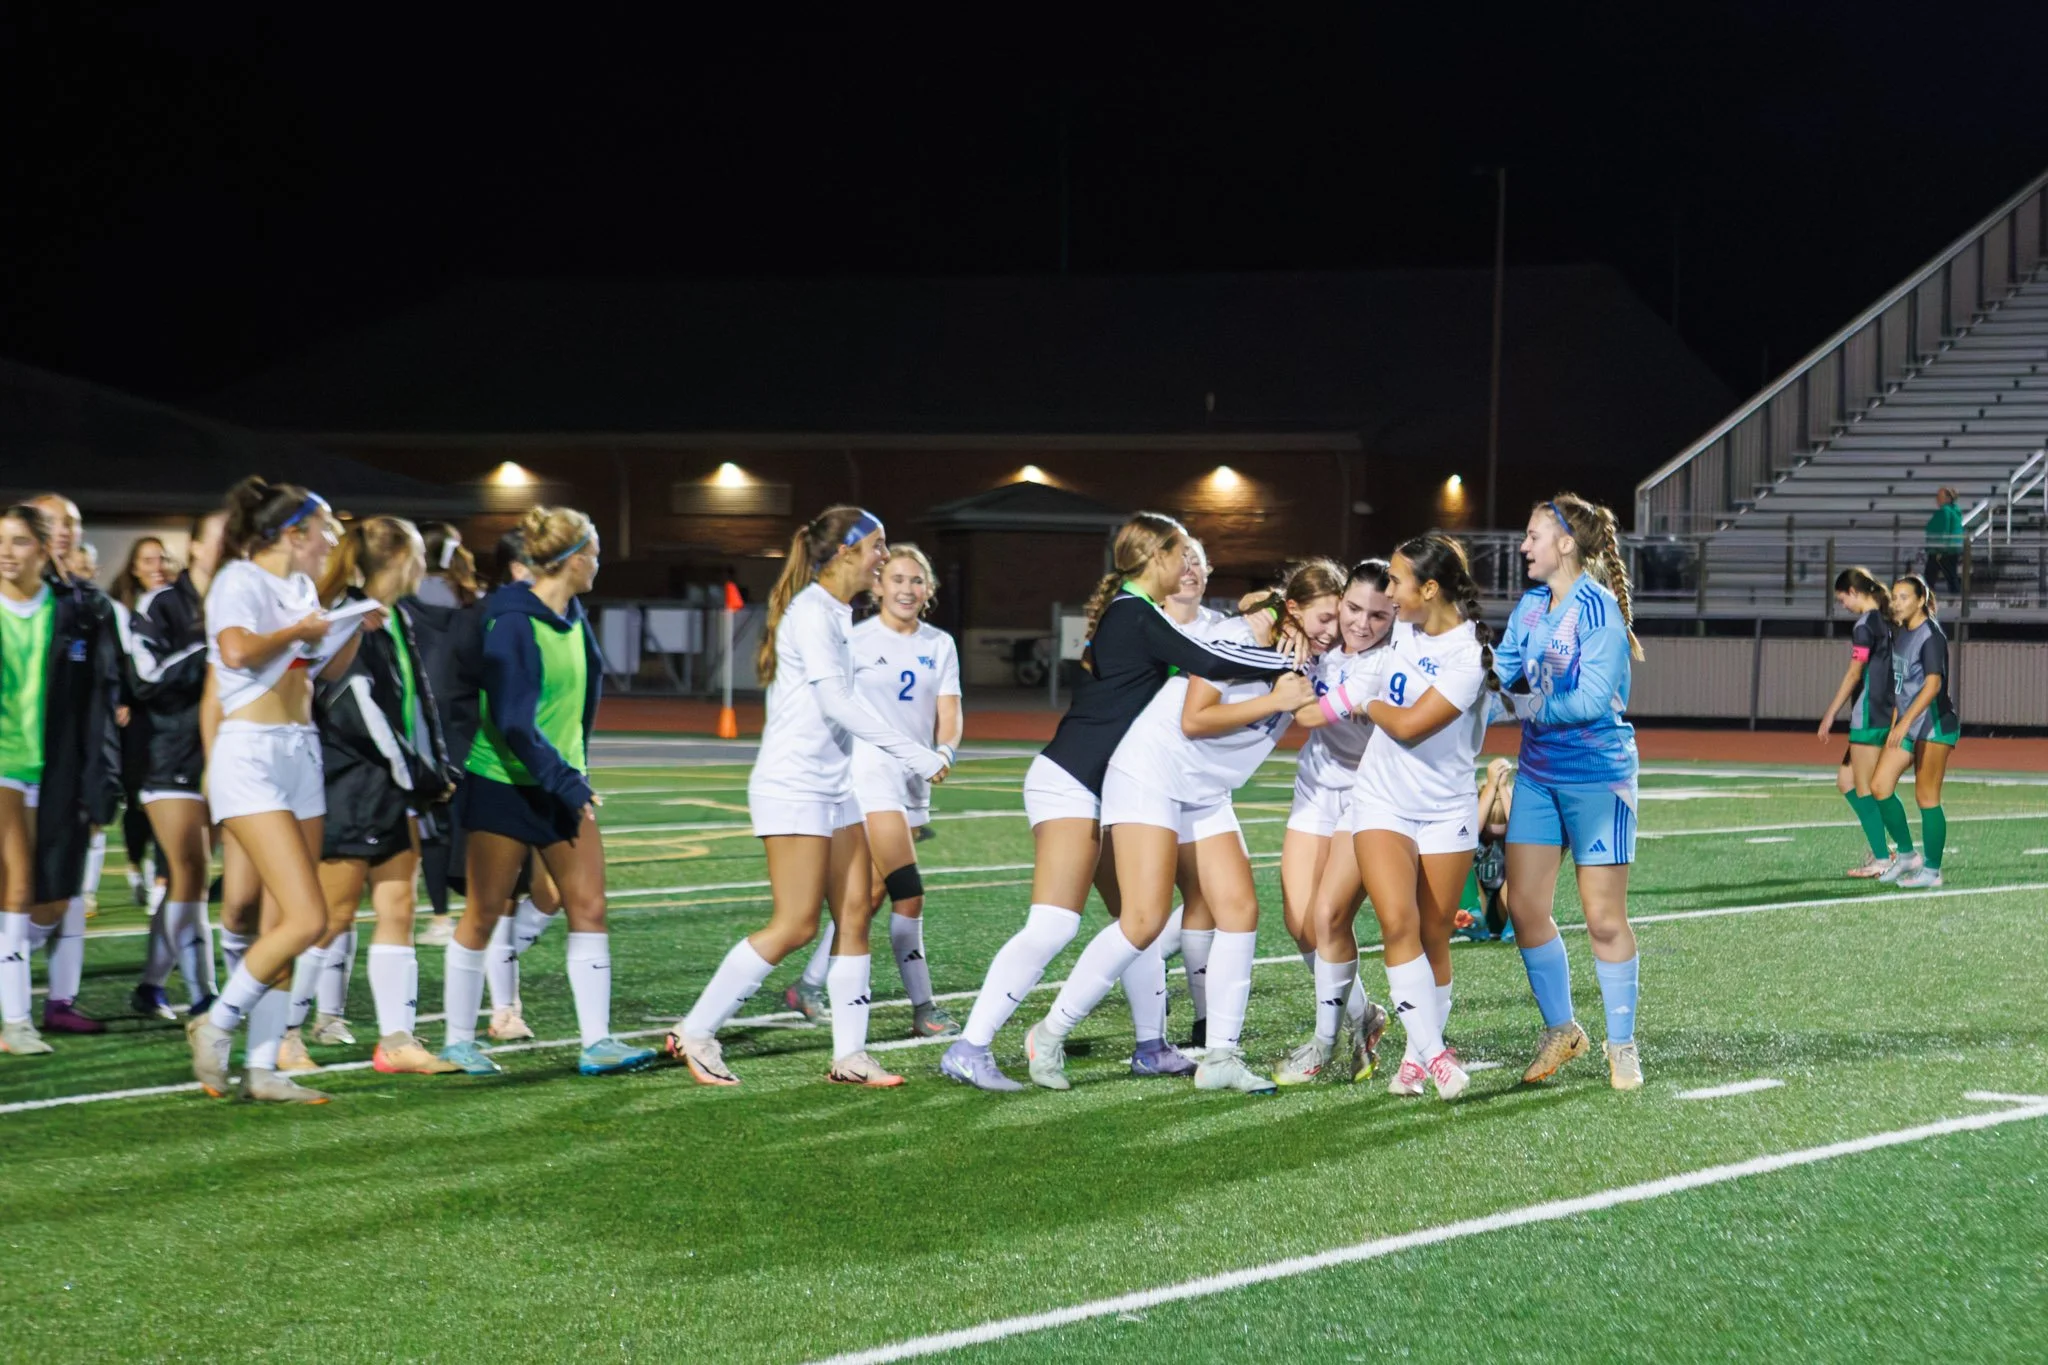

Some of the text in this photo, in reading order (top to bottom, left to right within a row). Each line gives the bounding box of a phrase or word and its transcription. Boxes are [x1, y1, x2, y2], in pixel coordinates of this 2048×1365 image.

[1551, 638, 1569, 655] WK
[899, 670, 916, 701] 2
[1389, 672, 1407, 706] 9
[1527, 658, 1554, 696] 28
